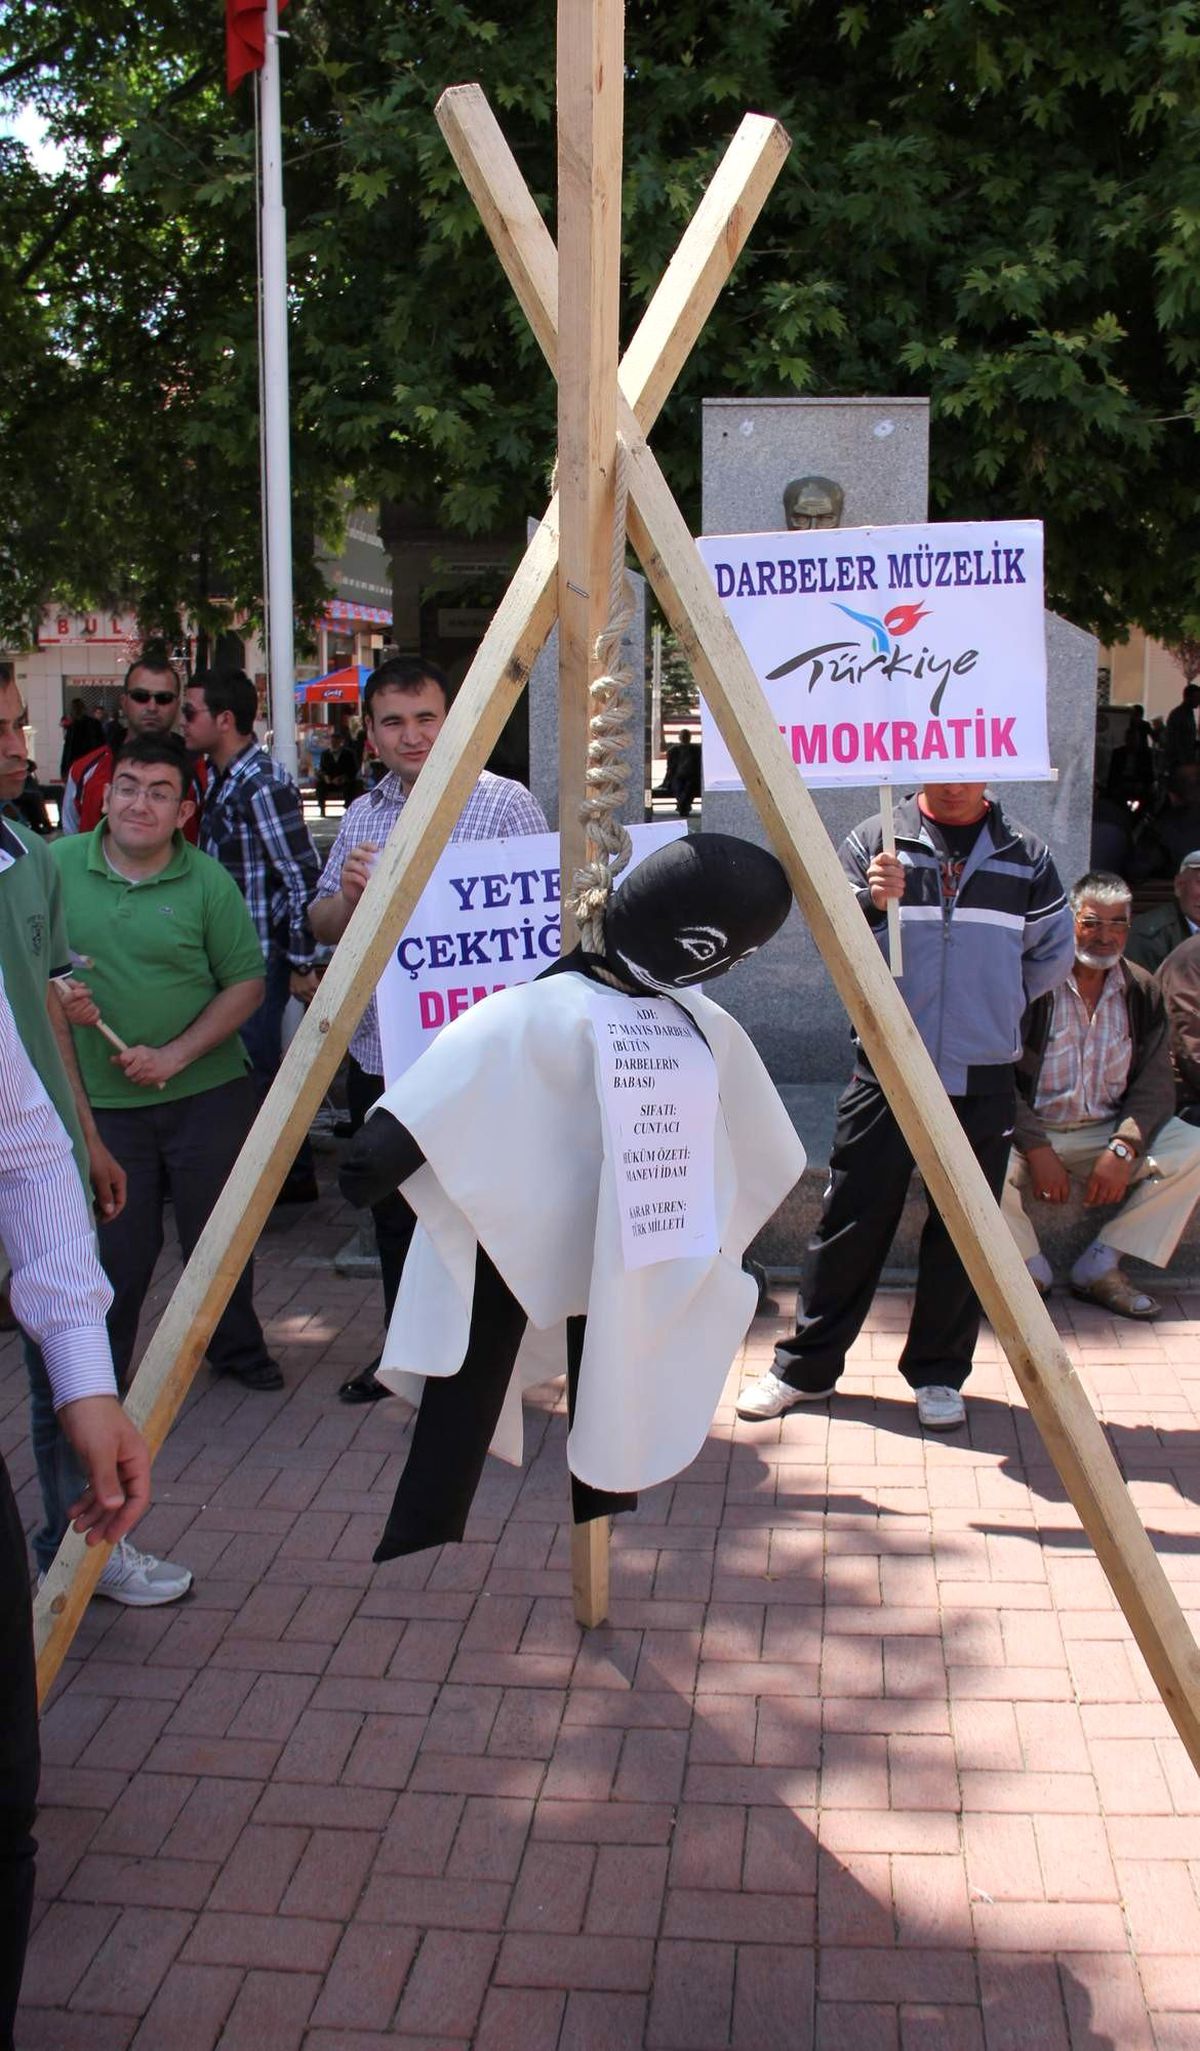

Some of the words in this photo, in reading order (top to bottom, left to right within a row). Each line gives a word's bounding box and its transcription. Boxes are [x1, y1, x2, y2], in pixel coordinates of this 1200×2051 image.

[715, 555, 878, 598] DARBELER
[888, 540, 1026, 589] MÜZELİK
[765, 641, 979, 717] Türkiye
[779, 708, 1018, 764] MOKRATİK
[449, 868, 561, 911] YETE
[397, 913, 561, 980] ÇEKTİĞ
